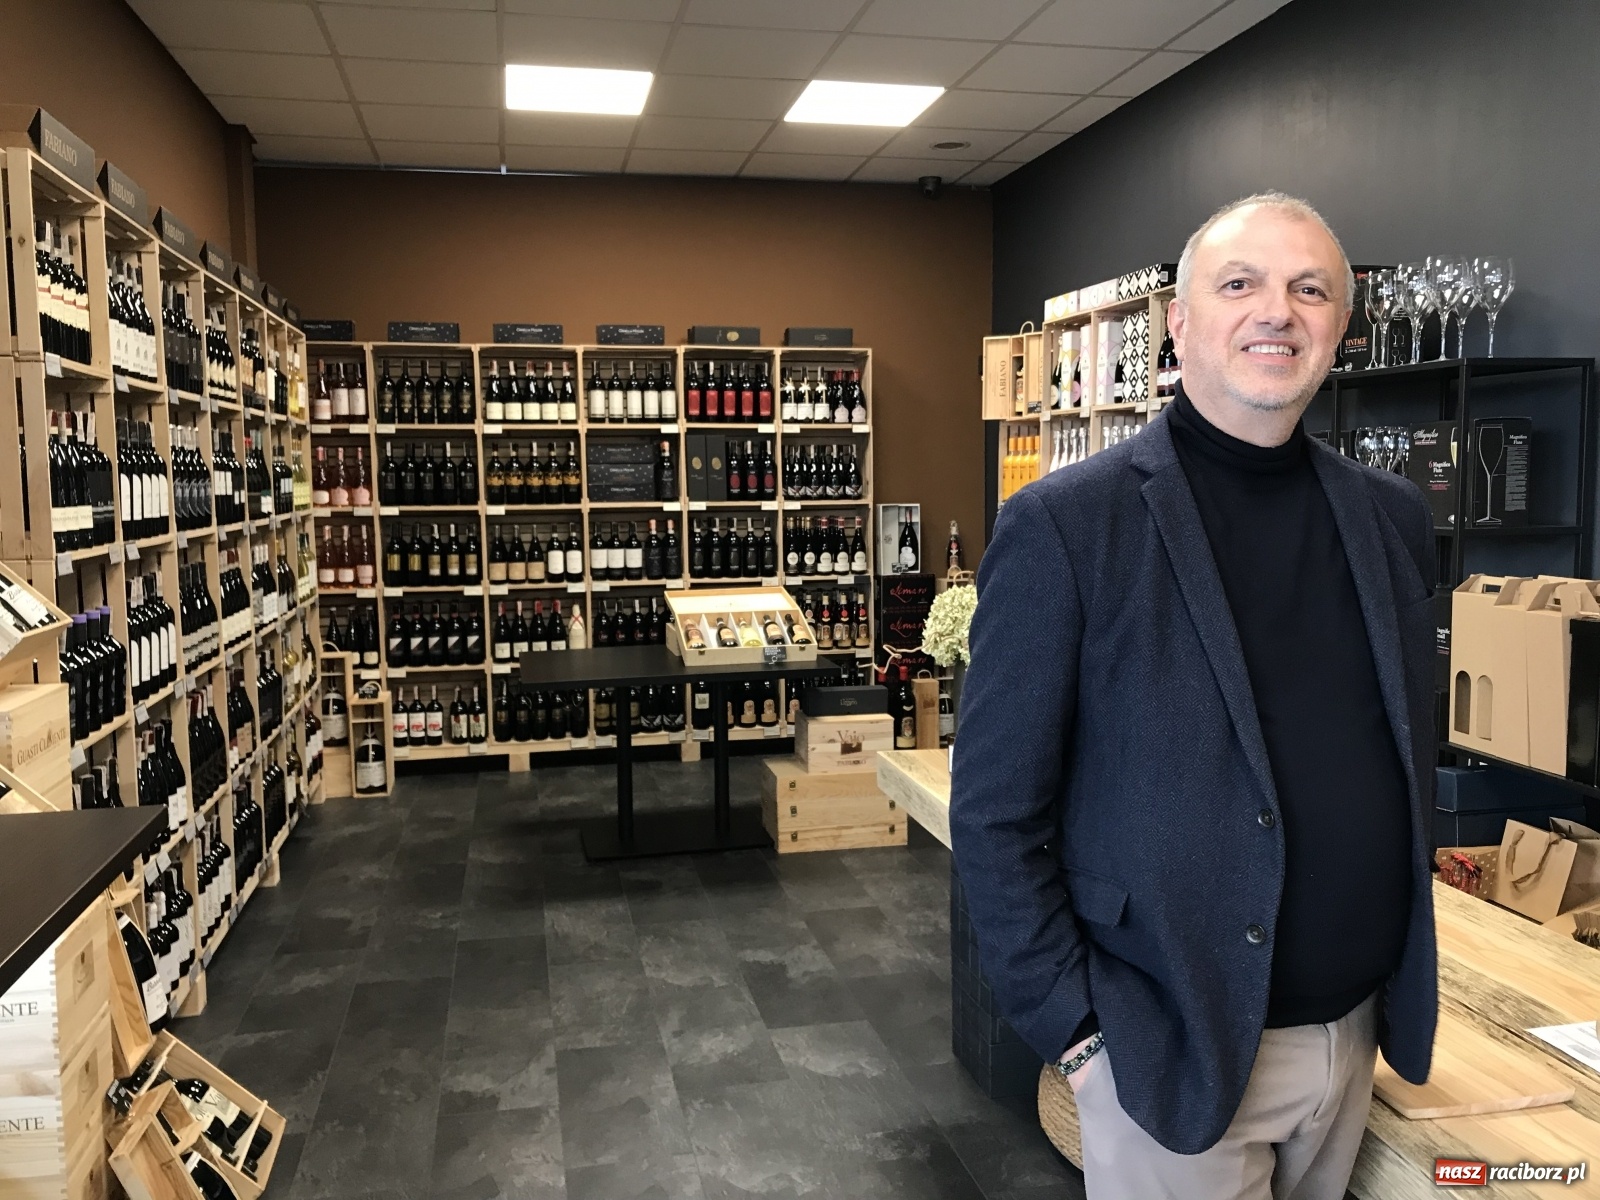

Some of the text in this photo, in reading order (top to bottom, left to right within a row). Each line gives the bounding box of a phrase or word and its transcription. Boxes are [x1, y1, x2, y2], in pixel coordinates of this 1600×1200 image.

[44, 128, 77, 167] FABIANO
[111, 178, 135, 209] FABIANO
[1345, 337, 1368, 347] VINTAGE
